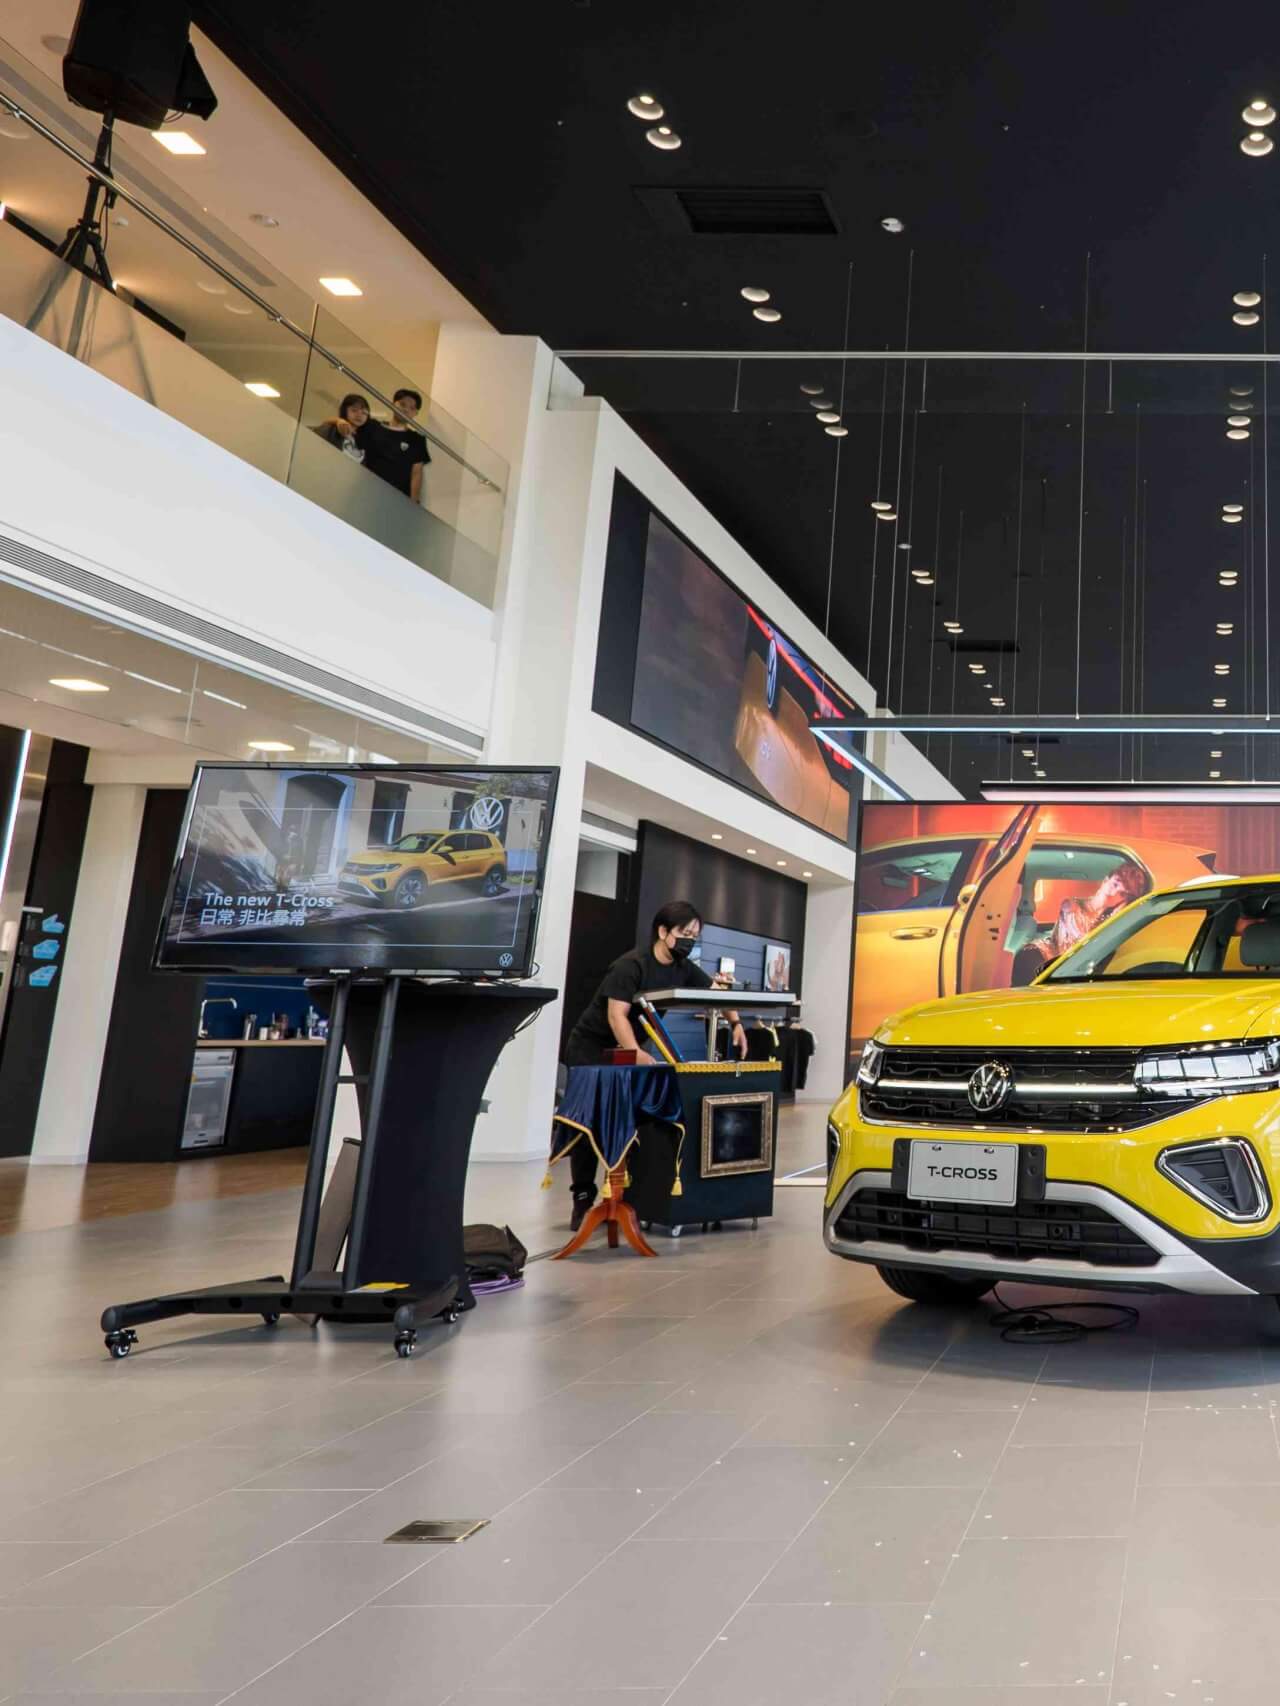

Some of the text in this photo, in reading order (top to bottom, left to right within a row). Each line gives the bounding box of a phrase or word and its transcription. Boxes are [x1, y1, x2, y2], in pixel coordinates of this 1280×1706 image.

[204, 892, 334, 907] The new T-Cross
[200, 909, 306, 926] 日常 非比尋常
[927, 1165, 998, 1181] T-CROSS
